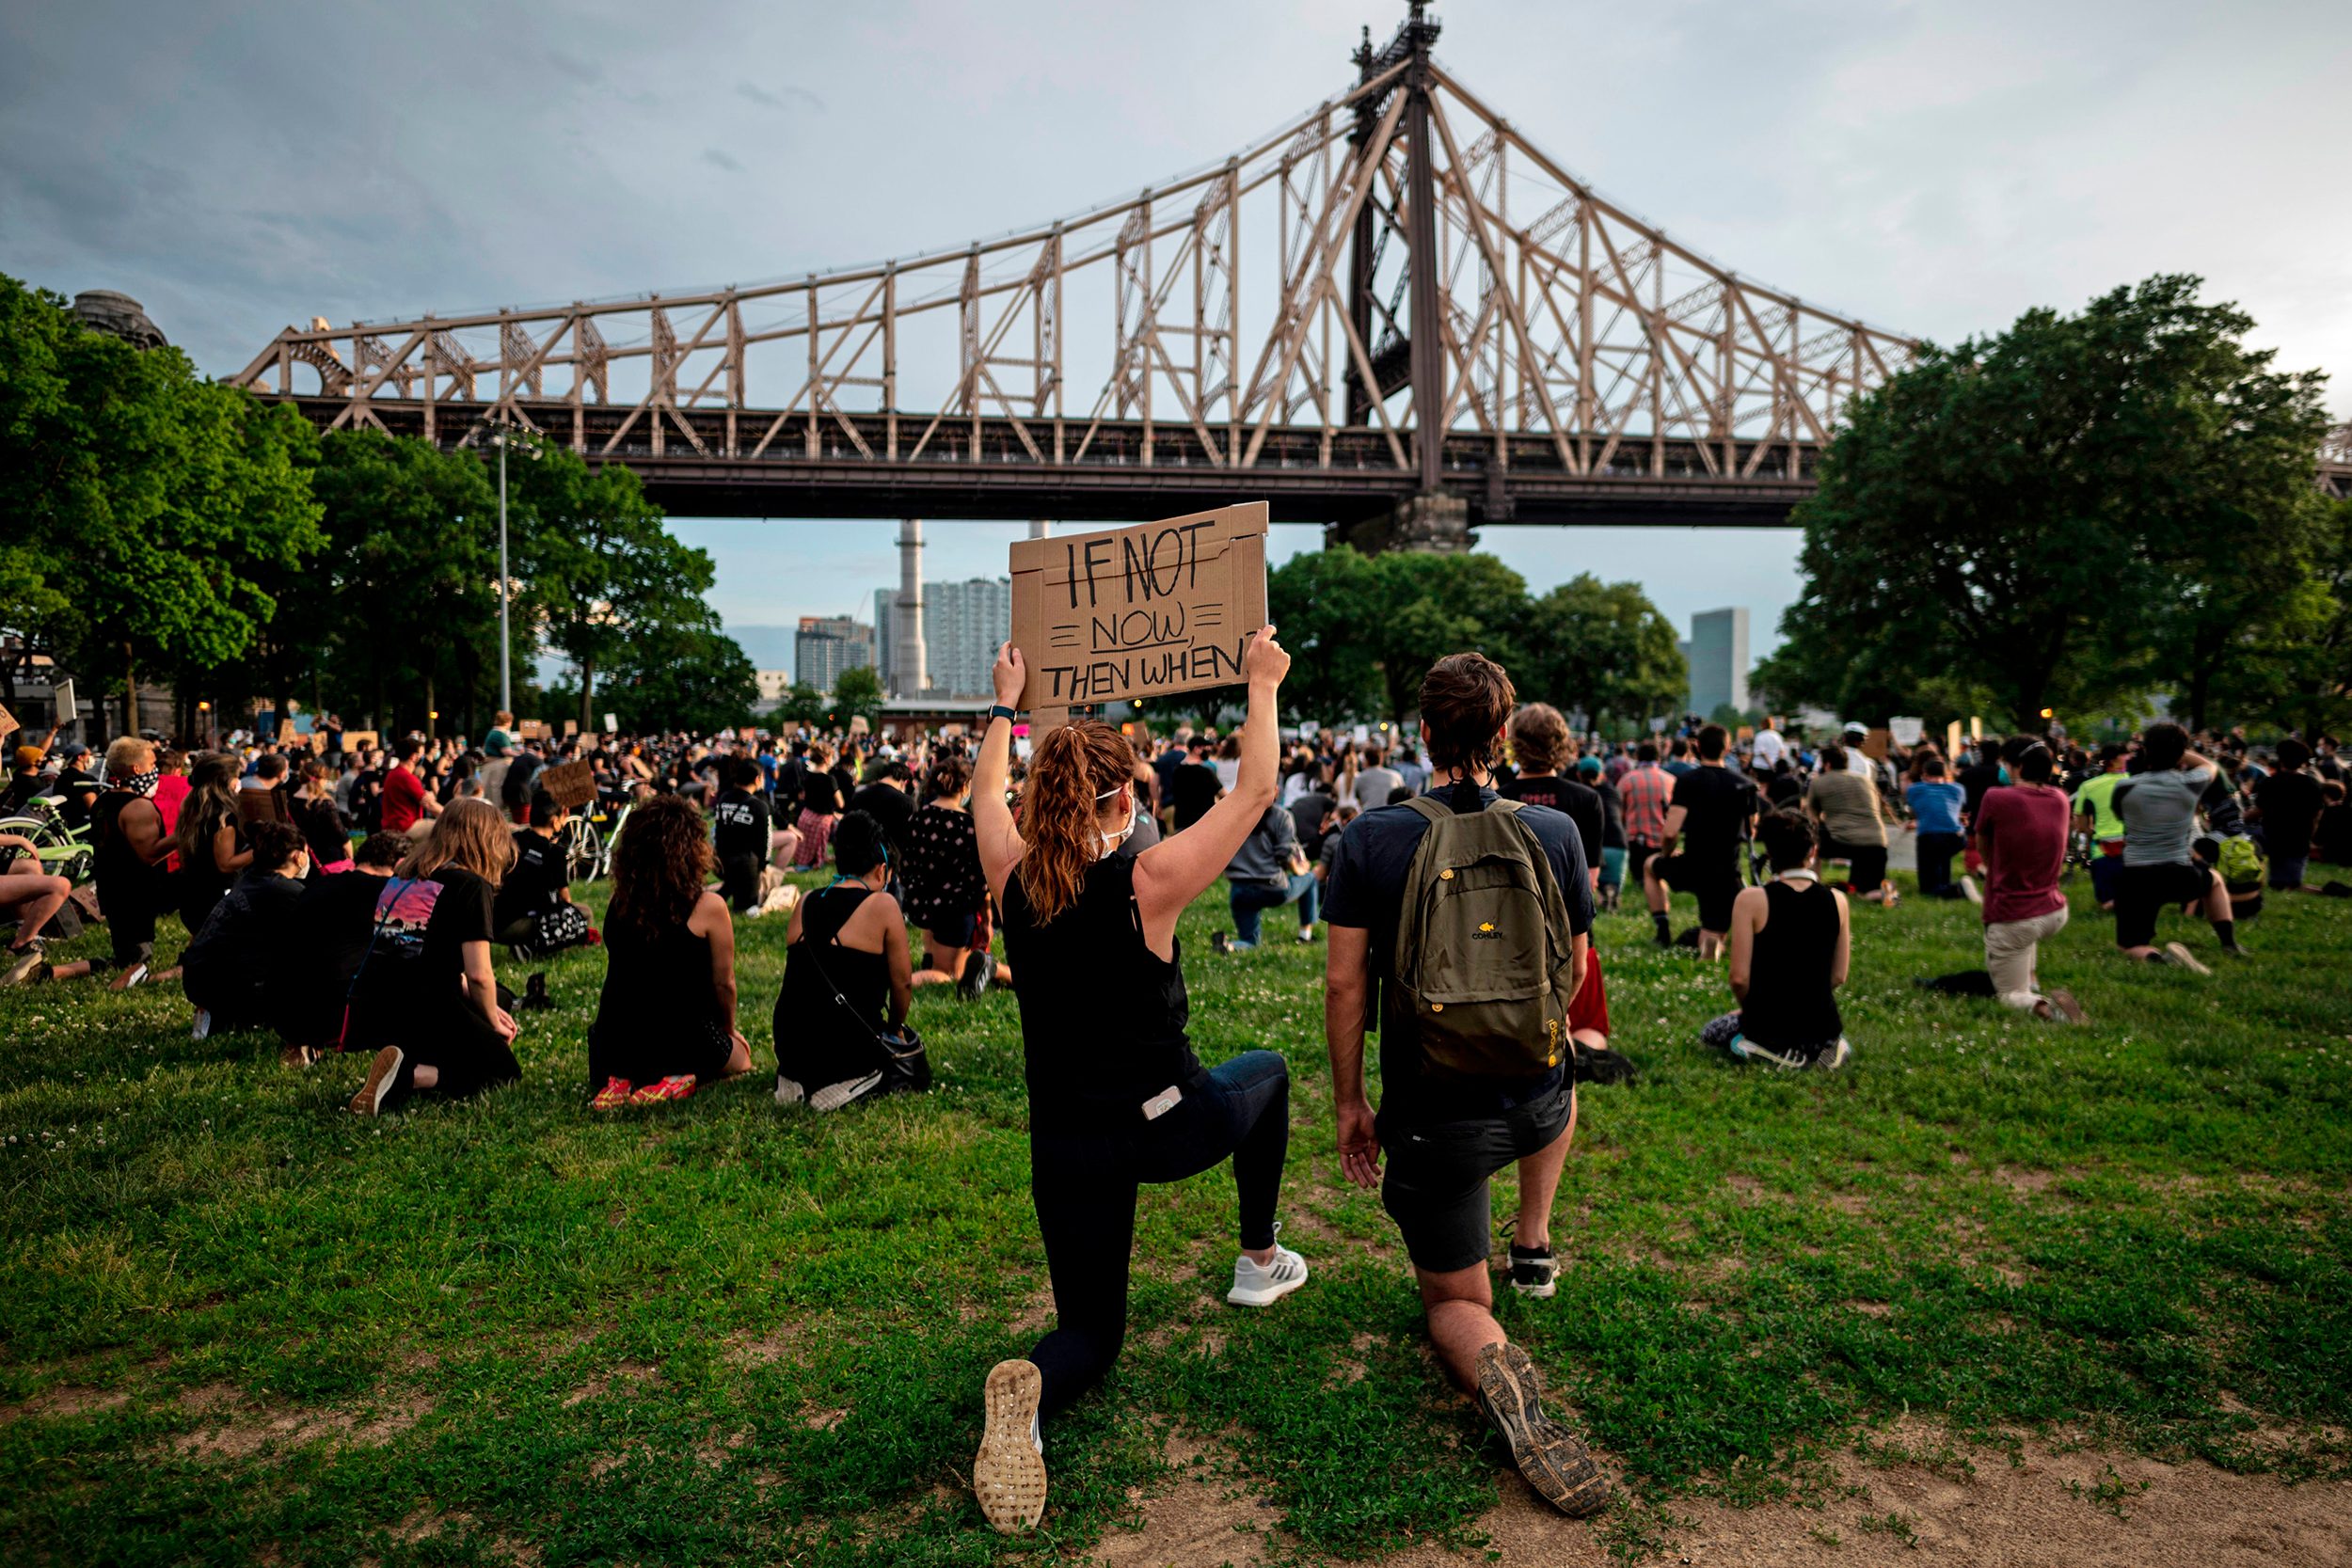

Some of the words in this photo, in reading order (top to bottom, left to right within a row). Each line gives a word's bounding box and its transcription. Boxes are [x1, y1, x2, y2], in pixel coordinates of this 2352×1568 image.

[1067, 538, 1113, 609] IF
[1123, 520, 1216, 603] NOT
[1041, 658, 1130, 701] THEN
[1141, 631, 1258, 685] WHEN
